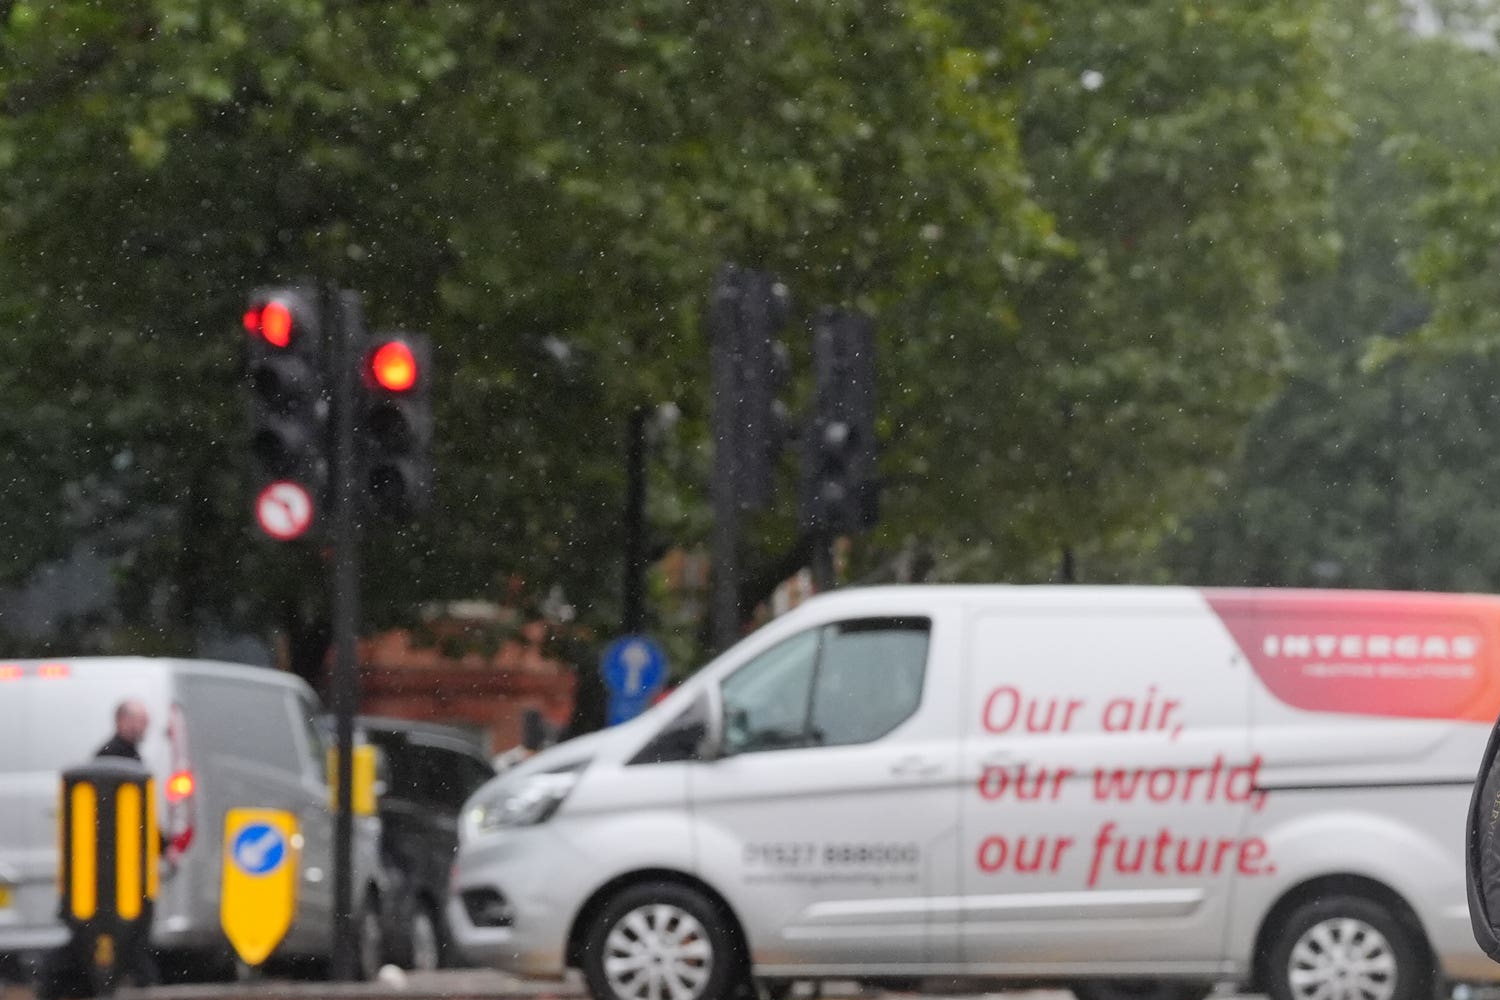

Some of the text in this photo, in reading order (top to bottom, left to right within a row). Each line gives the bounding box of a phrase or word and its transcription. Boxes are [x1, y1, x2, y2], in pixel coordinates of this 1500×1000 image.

[1263, 634, 1475, 659] INTERGAS
[981, 684, 1185, 741] Our air,
[977, 752, 1271, 812] our world,
[976, 820, 1277, 889] our future.
